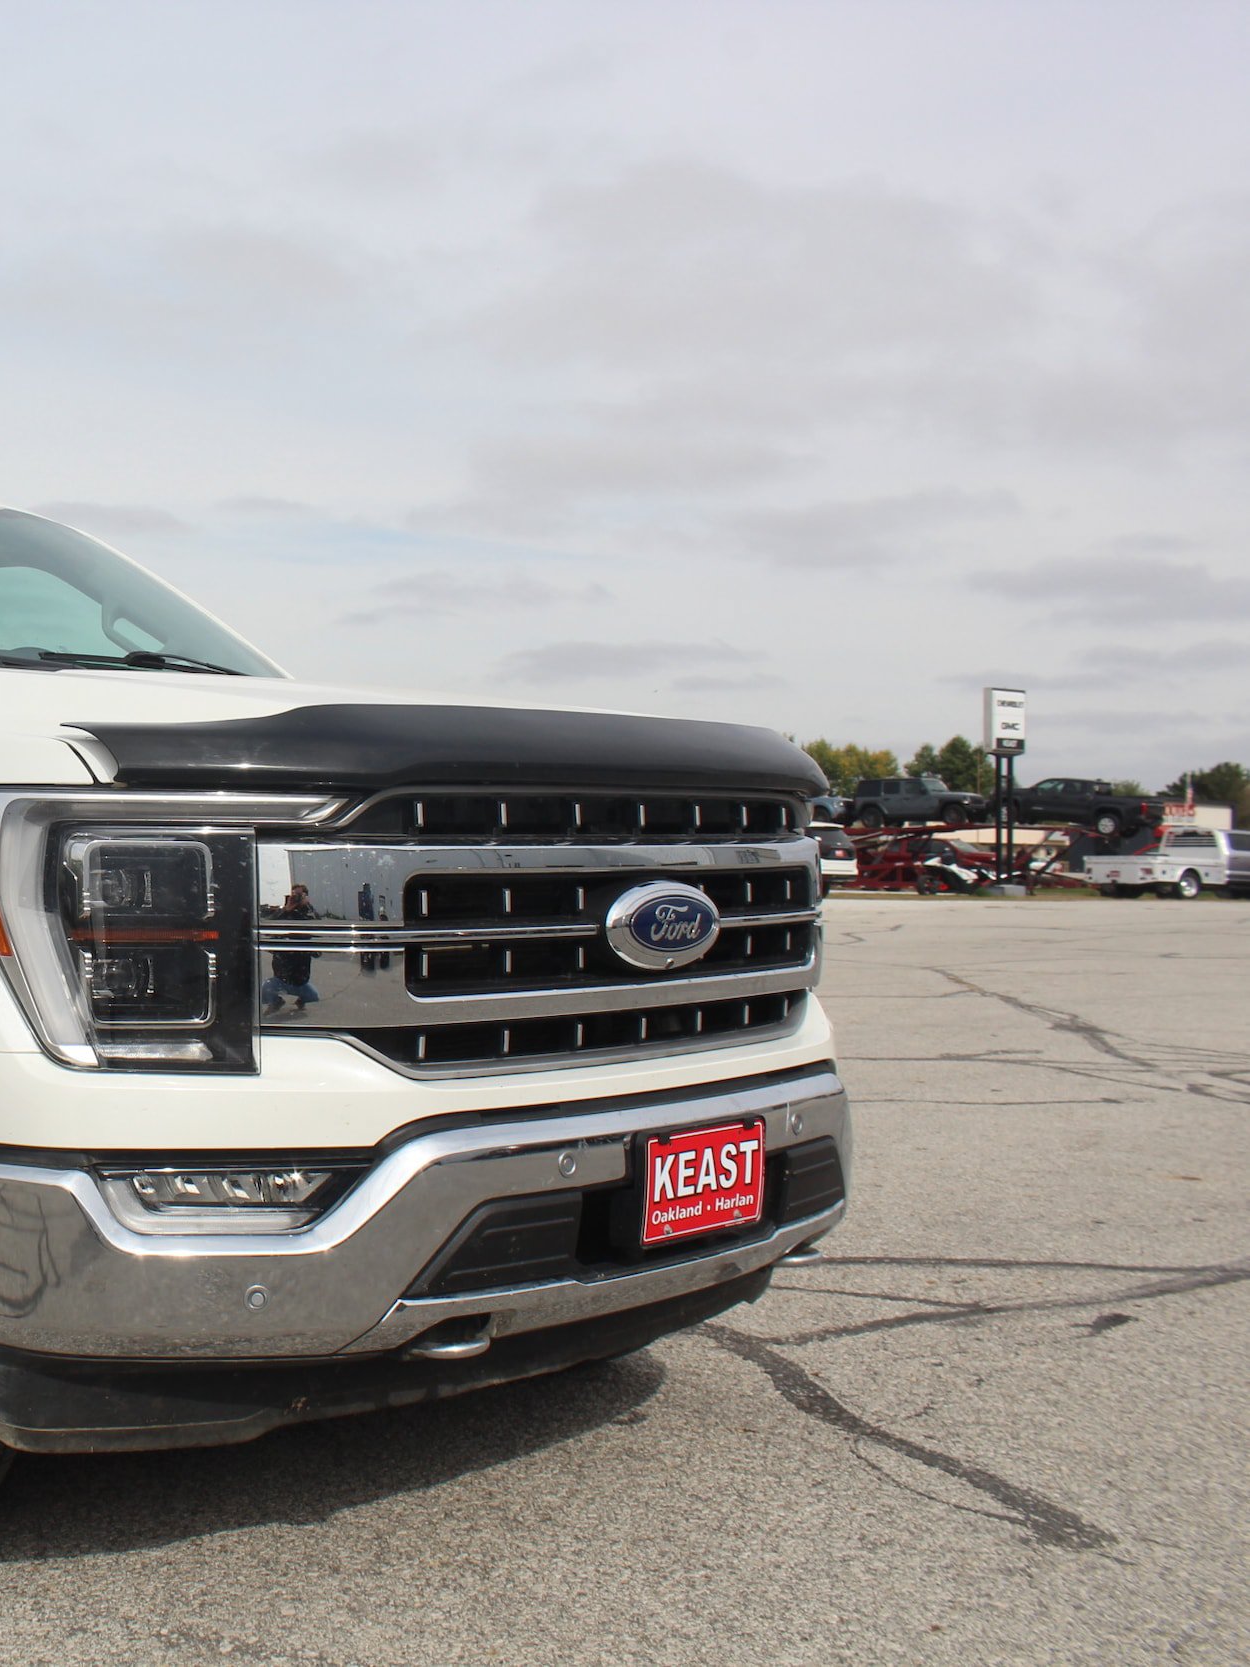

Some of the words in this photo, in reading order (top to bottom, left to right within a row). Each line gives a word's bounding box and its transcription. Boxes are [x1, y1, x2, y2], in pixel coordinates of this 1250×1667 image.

[650, 904, 702, 942] Ford
[653, 1139, 759, 1204] KEAST
[651, 1200, 703, 1225] Oakland
[715, 1193, 755, 1212] Harlan
